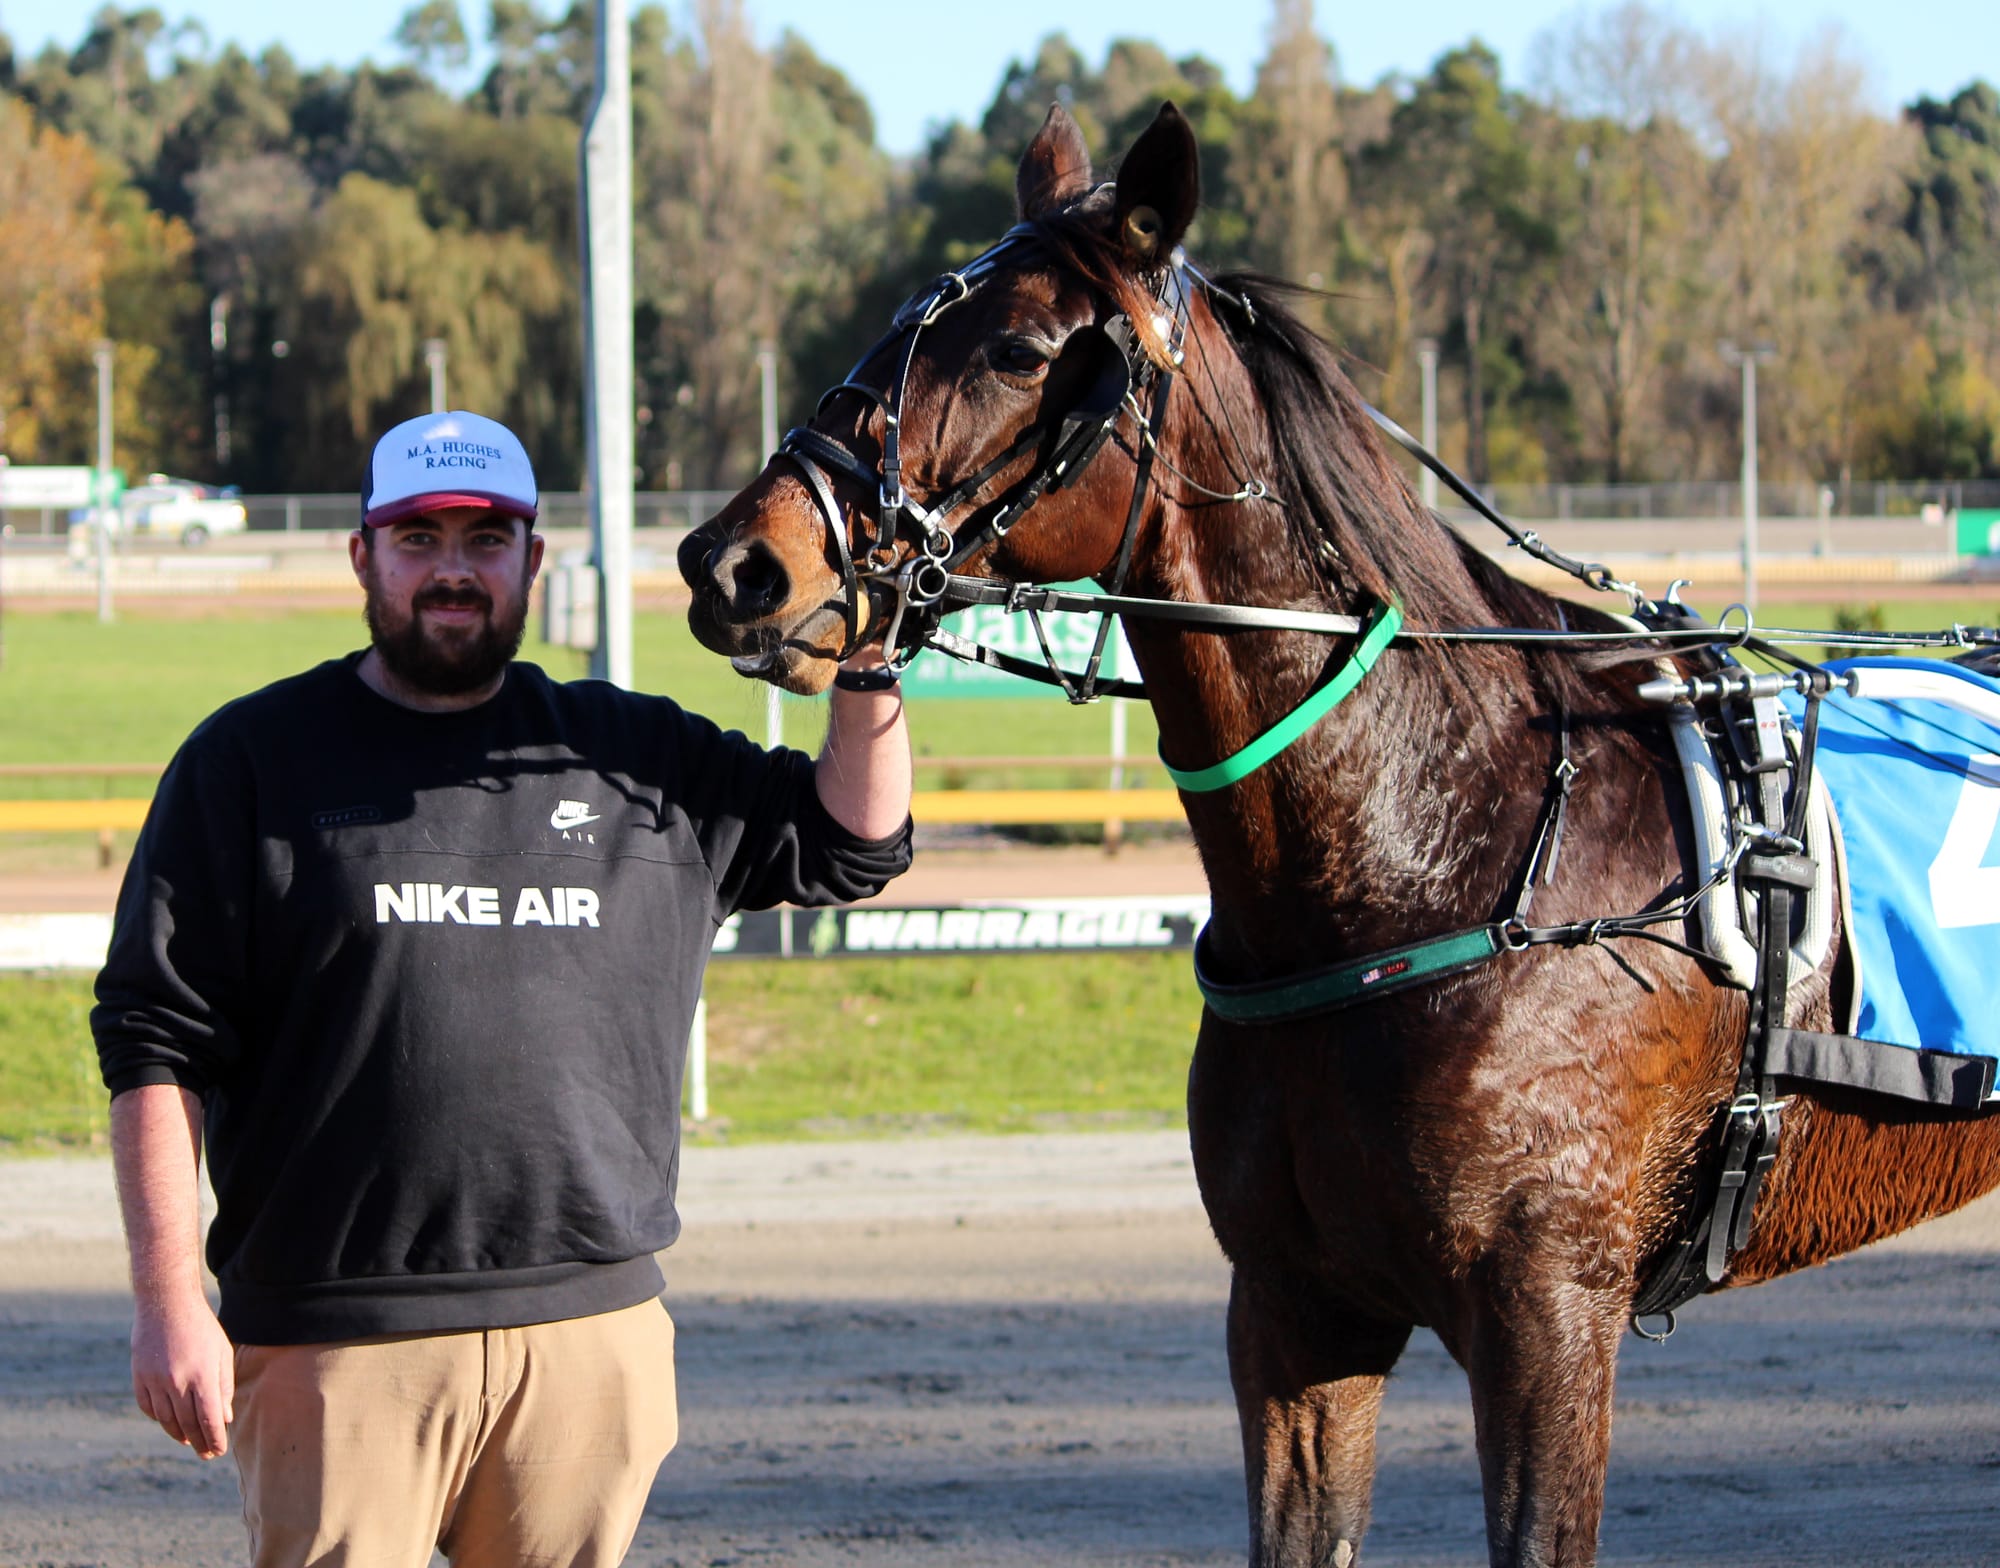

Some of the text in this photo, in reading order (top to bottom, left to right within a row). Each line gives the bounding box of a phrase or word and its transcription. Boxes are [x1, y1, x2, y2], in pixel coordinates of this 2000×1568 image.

[407, 442, 501, 459] M.A. HUGHES
[425, 456, 486, 469] RACING
[557, 799, 590, 819] NIKE
[562, 829, 595, 845] AIR
[374, 882, 600, 927] NIKE AIR
[845, 910, 1175, 948] WARRAGUL
